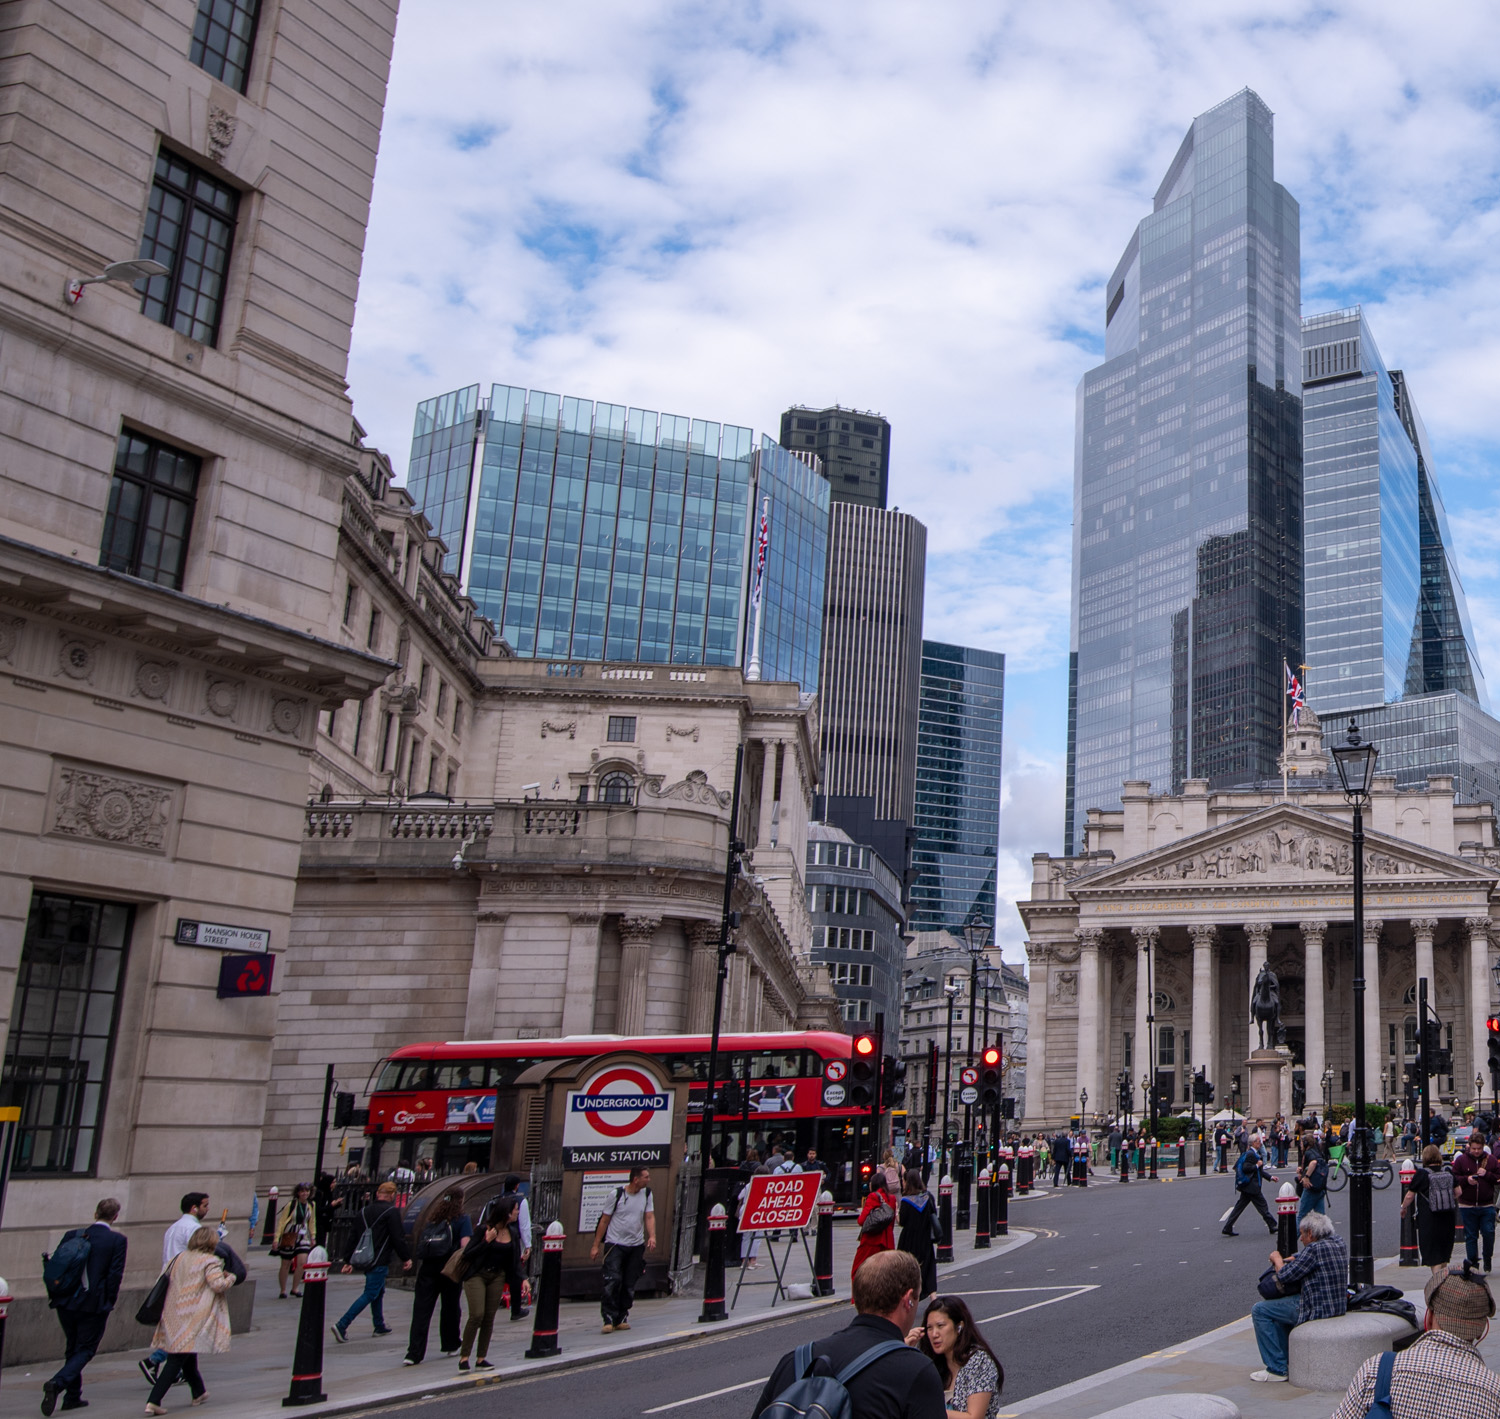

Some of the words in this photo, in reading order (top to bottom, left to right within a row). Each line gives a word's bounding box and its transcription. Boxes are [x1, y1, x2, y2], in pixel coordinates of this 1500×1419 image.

[1095, 903, 1122, 912] ANNO
[1128, 901, 1195, 911] ELIZABETHAE
[1291, 898, 1318, 907] ANNO
[203, 935, 229, 945] STREET
[205, 927, 238, 937] MANSION
[240, 931, 263, 941] HOUSE
[248, 941, 262, 949] EC2
[576, 1096, 664, 1109] UNDERGROUND
[393, 1110, 416, 1124] Go
[571, 1151, 605, 1163] BANK
[610, 1150, 660, 1162] STATION
[765, 1179, 804, 1194] ROAD
[757, 1194, 804, 1210] AHEAD
[750, 1208, 803, 1224] CLOSED
